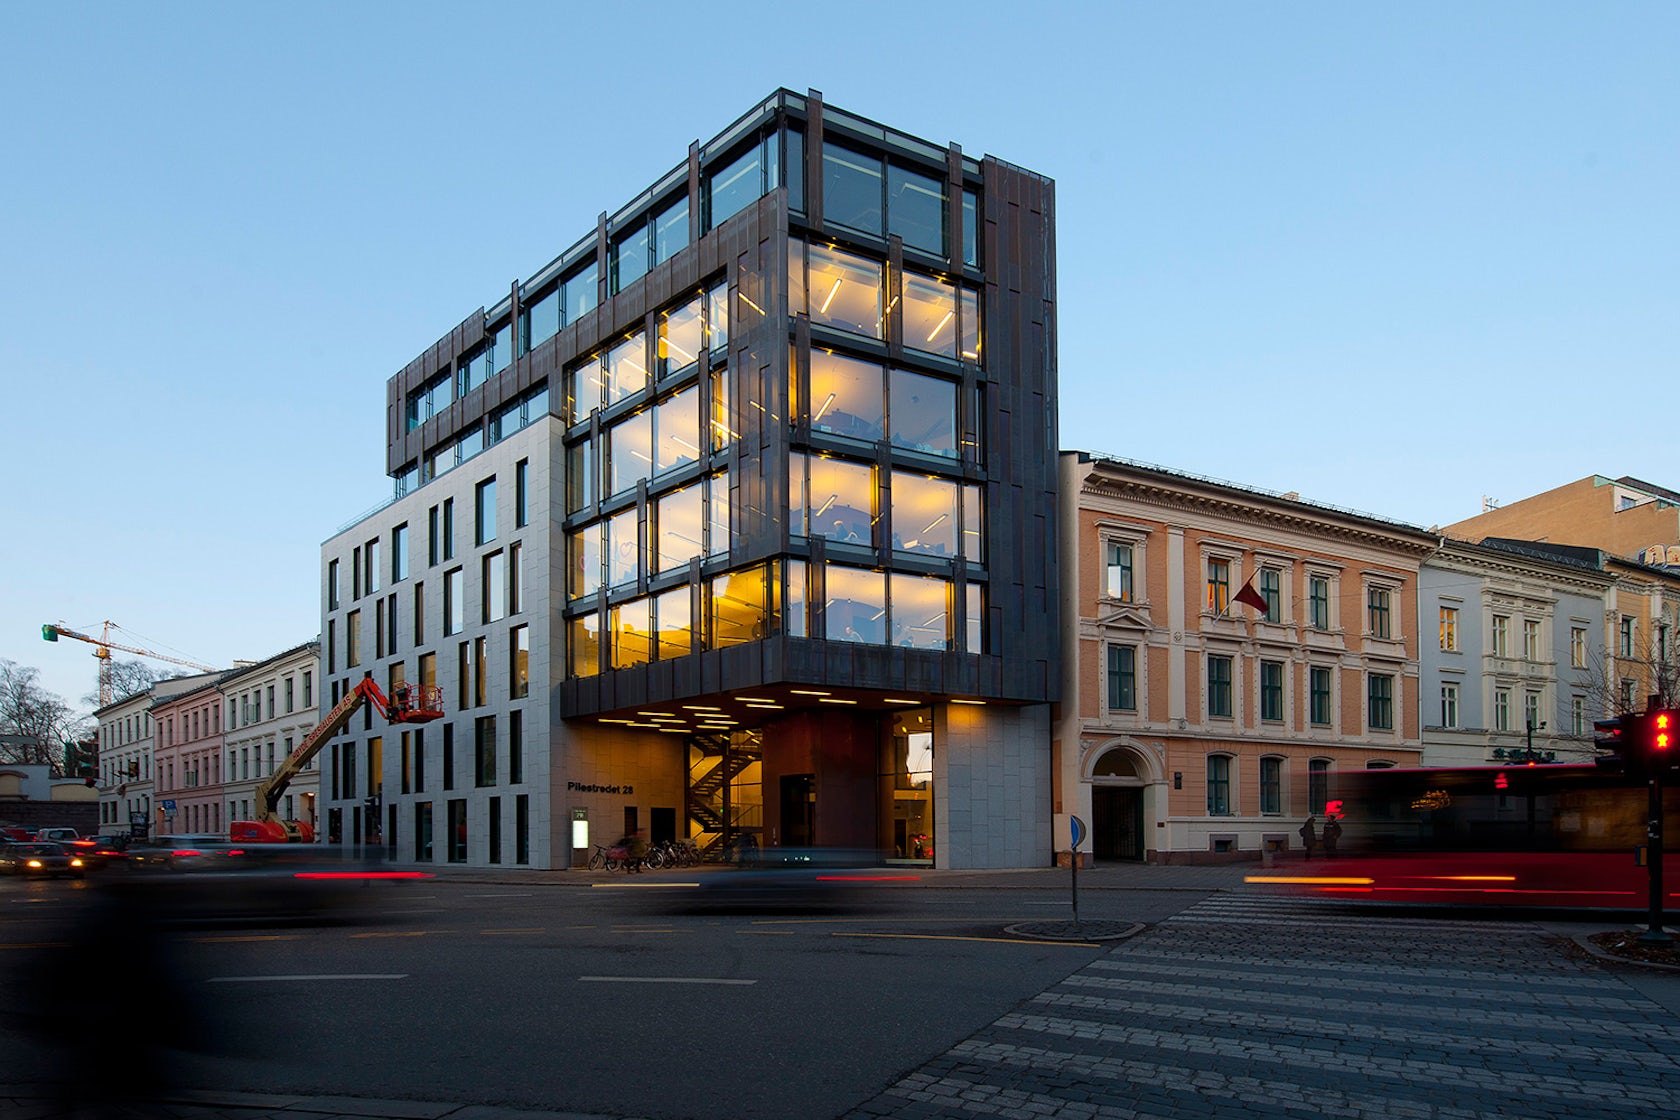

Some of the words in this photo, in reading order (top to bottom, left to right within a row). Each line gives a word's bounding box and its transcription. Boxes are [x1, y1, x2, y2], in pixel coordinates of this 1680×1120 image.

[308, 704, 343, 743] SPESIALISTEN
[343, 695, 351, 707] AS
[567, 782, 621, 794] Pilestredet
[622, 785, 633, 794] 28
